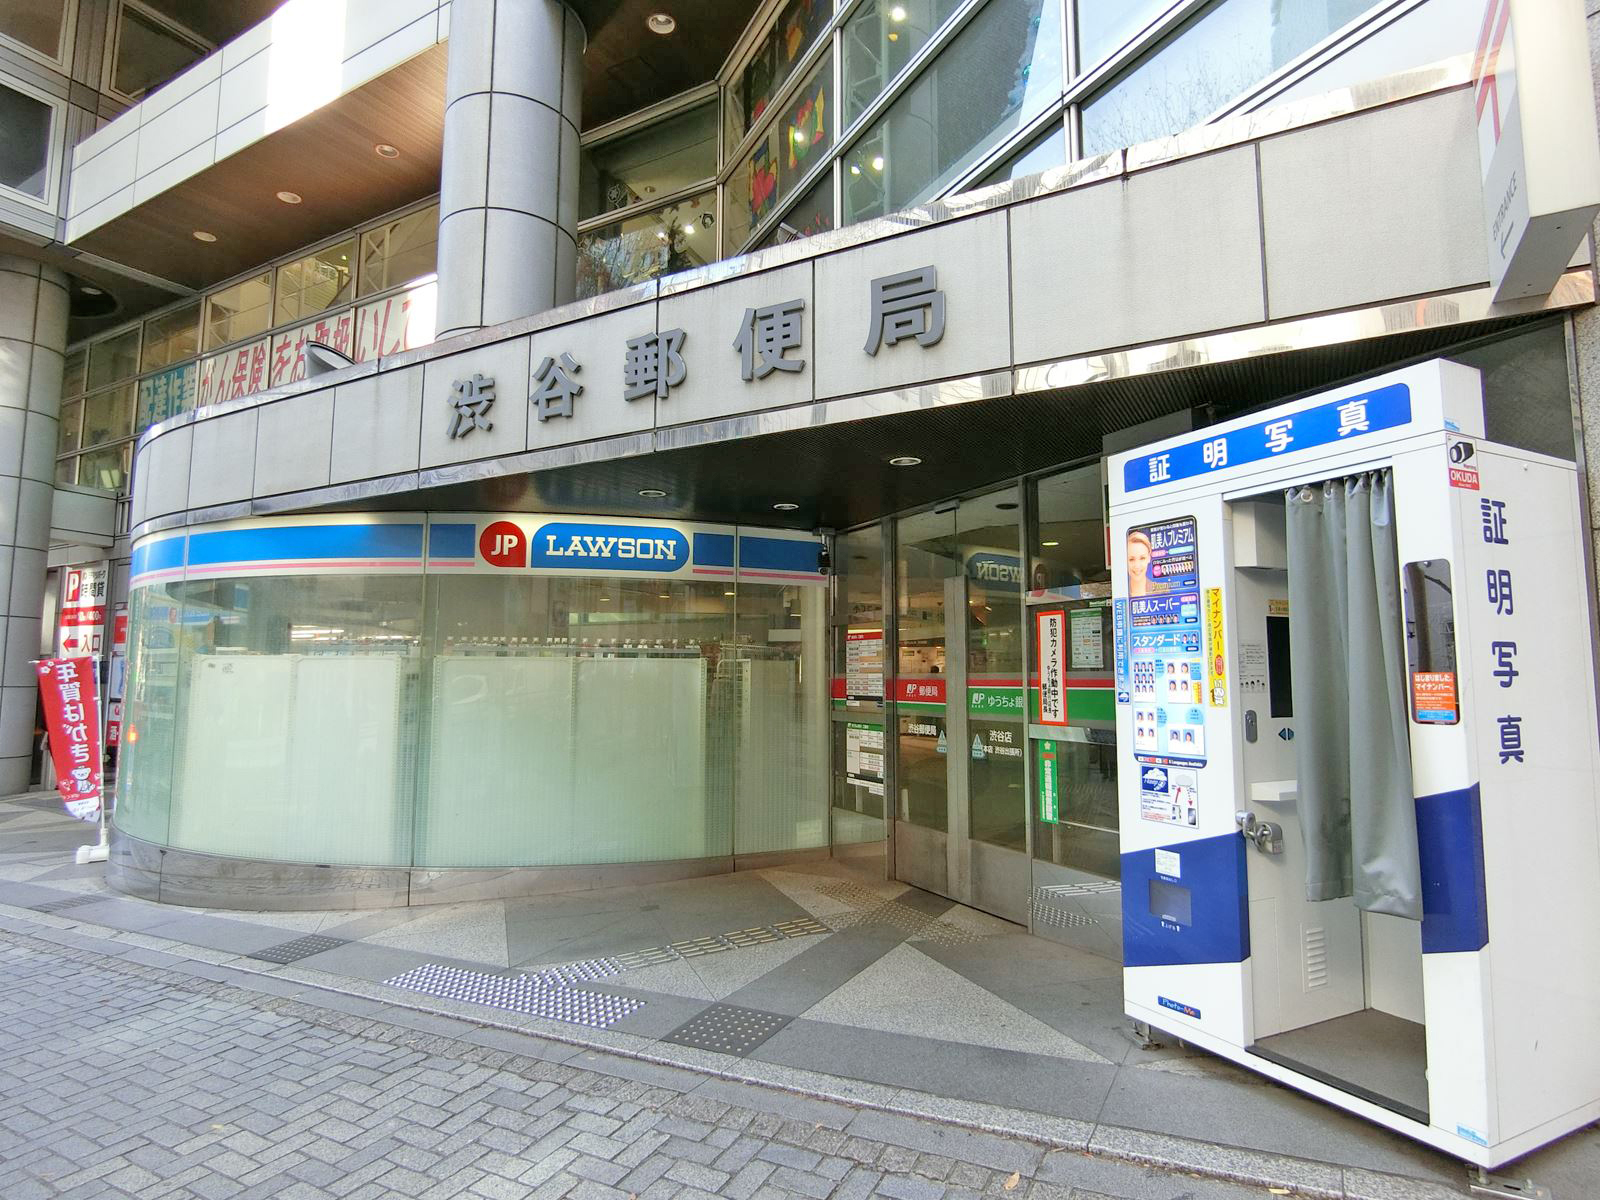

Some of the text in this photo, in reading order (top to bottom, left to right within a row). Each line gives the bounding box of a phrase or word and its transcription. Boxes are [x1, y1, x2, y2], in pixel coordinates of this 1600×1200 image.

[446, 265, 947, 440] 渋谷郵便局
[1147, 398, 1371, 485] 証明写真
[1450, 470, 1478, 484] OKUDA
[490, 533, 518, 557] JP
[546, 534, 677, 561] LAWSON
[1151, 527, 1194, 550] 肌美人プレミアム
[1132, 597, 1180, 615] 肌美人スーパー
[1211, 588, 1222, 651] マイナンバー
[1133, 634, 1181, 648] スタンダード
[1479, 497, 1524, 765] 証明写真
[81, 634, 100, 652] 入口
[1049, 618, 1059, 718] 防犯カメラ作動中です
[919, 685, 938, 697] 郵便局
[907, 723, 937, 736] 渋谷郵便局
[989, 730, 1013, 743] 渋谷店
[1161, 999, 1196, 1016] Photo-Me
